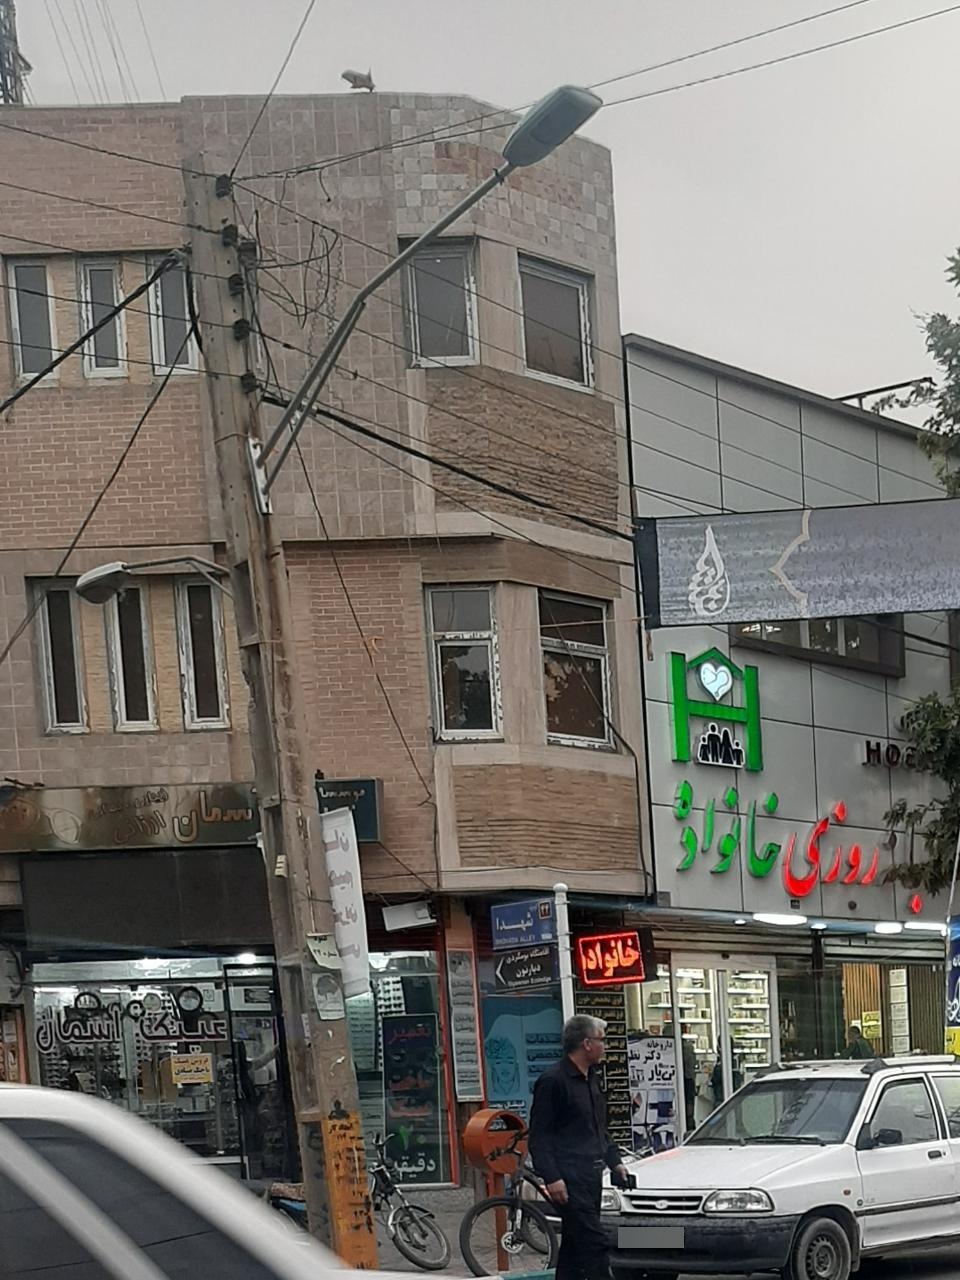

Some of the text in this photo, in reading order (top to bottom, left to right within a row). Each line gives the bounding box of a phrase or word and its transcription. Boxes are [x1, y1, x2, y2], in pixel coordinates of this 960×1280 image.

[172, 790, 253, 843] سمان
[495, 912, 534, 932] شهدا
[647, 1040, 673, 1051] داروخانه
[643, 1050, 661, 1064] دکتر
